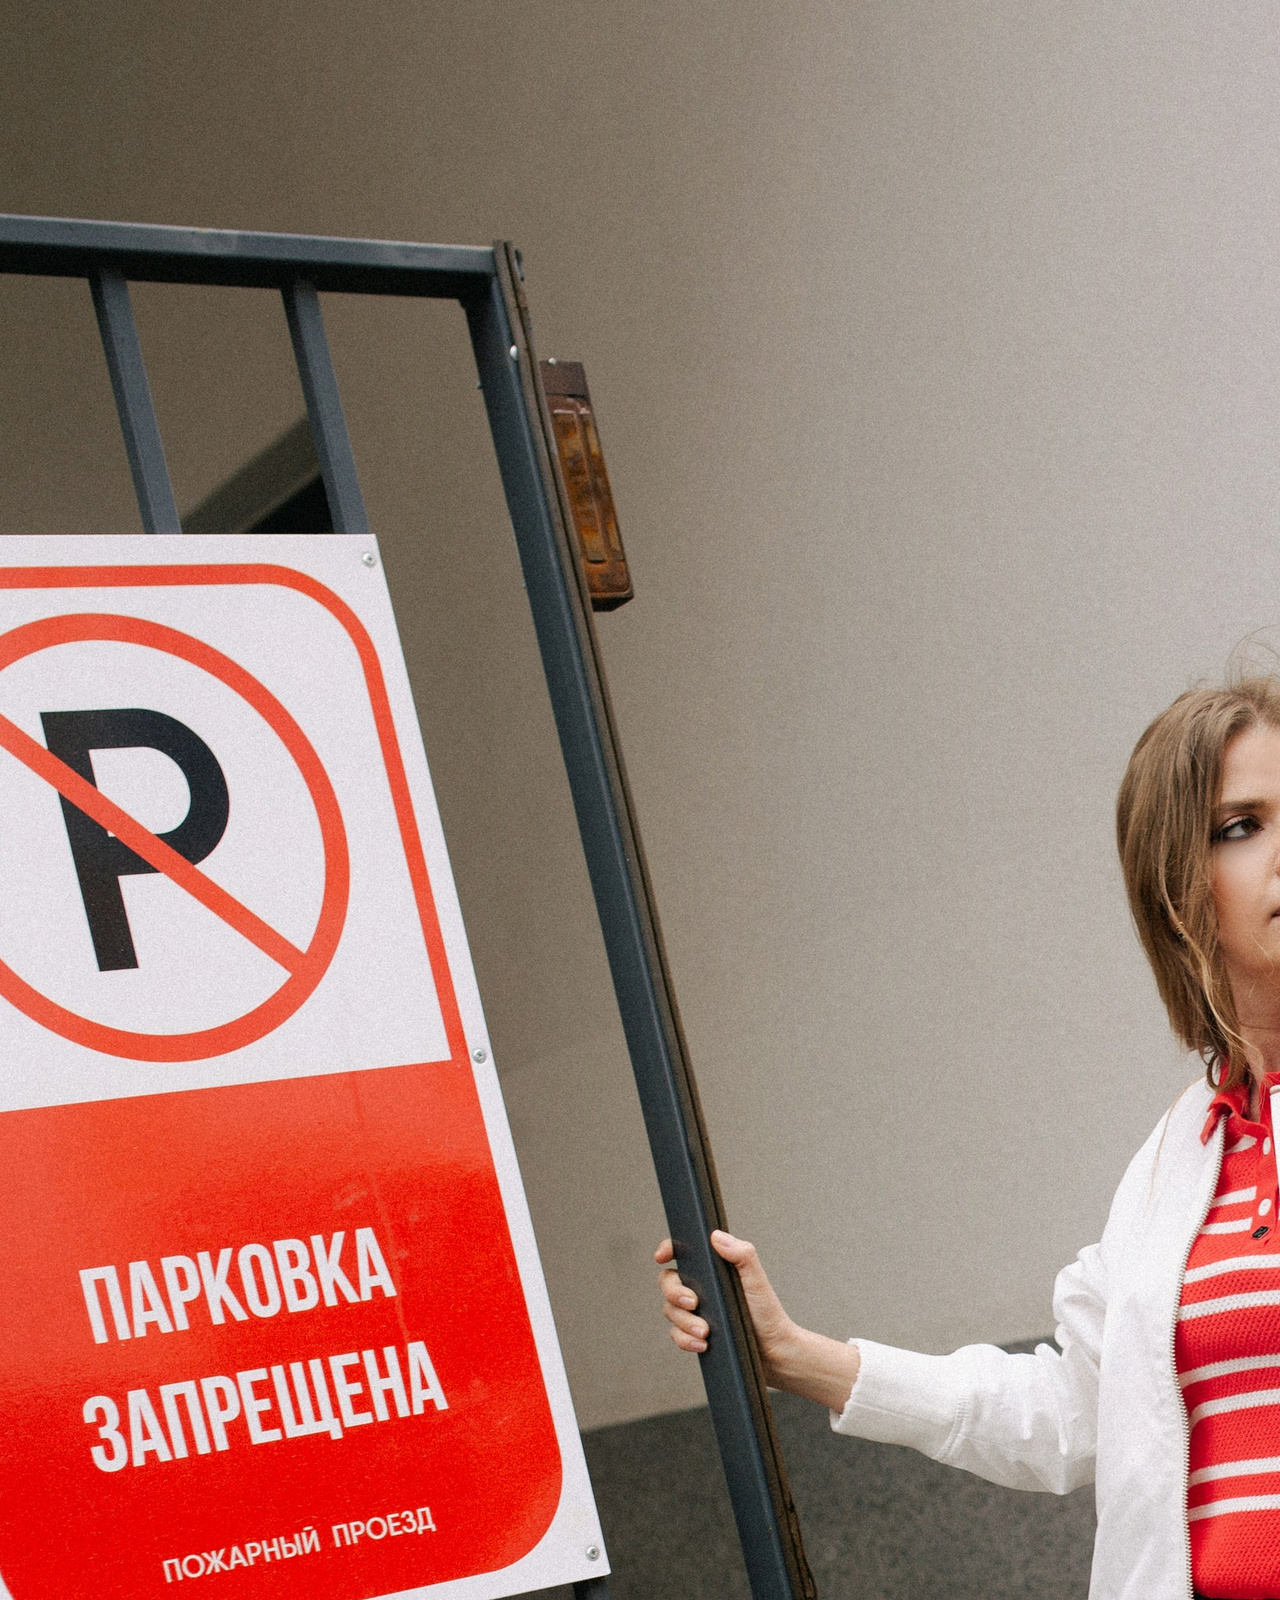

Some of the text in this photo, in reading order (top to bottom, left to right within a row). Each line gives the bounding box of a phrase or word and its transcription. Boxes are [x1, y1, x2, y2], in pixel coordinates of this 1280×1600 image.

[39, 708, 230, 972] P
[78, 1226, 398, 1345] ПАРКОВКА
[82, 1340, 449, 1473] ЗАПРЕЩЕНА
[162, 1506, 437, 1583] ПОЖАРНЫЙ ПРОЕЗД
